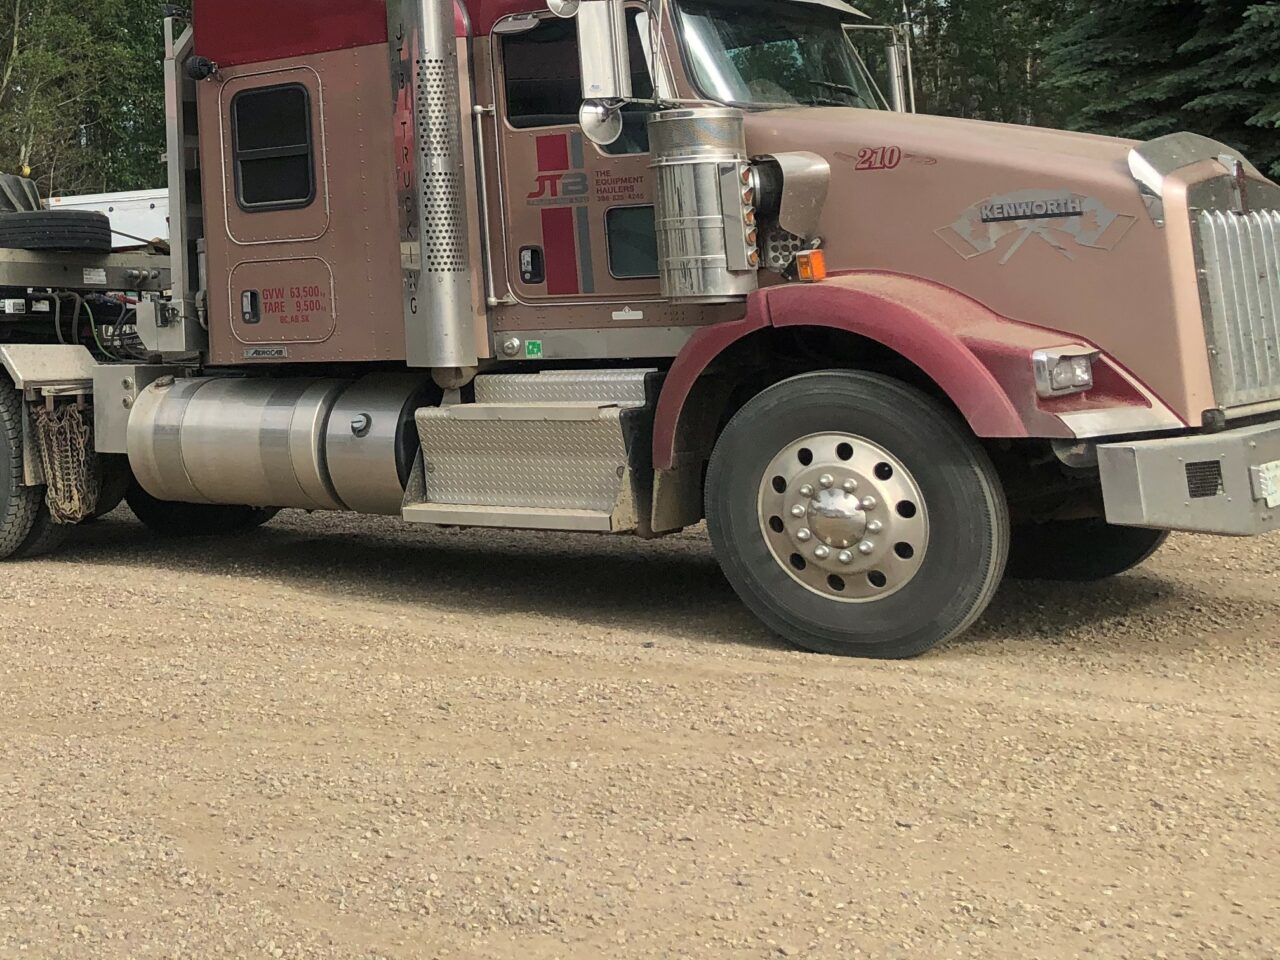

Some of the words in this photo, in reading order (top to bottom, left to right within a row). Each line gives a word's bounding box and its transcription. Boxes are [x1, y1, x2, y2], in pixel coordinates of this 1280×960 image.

[854, 146, 902, 171] 210
[526, 172, 589, 198] JTB
[595, 176, 644, 186] EQUIPMENT
[596, 185, 634, 194] HAULERS
[981, 199, 1083, 222] KENWORTH
[262, 288, 285, 300] GVW
[263, 301, 286, 313] TARE
[296, 300, 321, 313] 9,500
